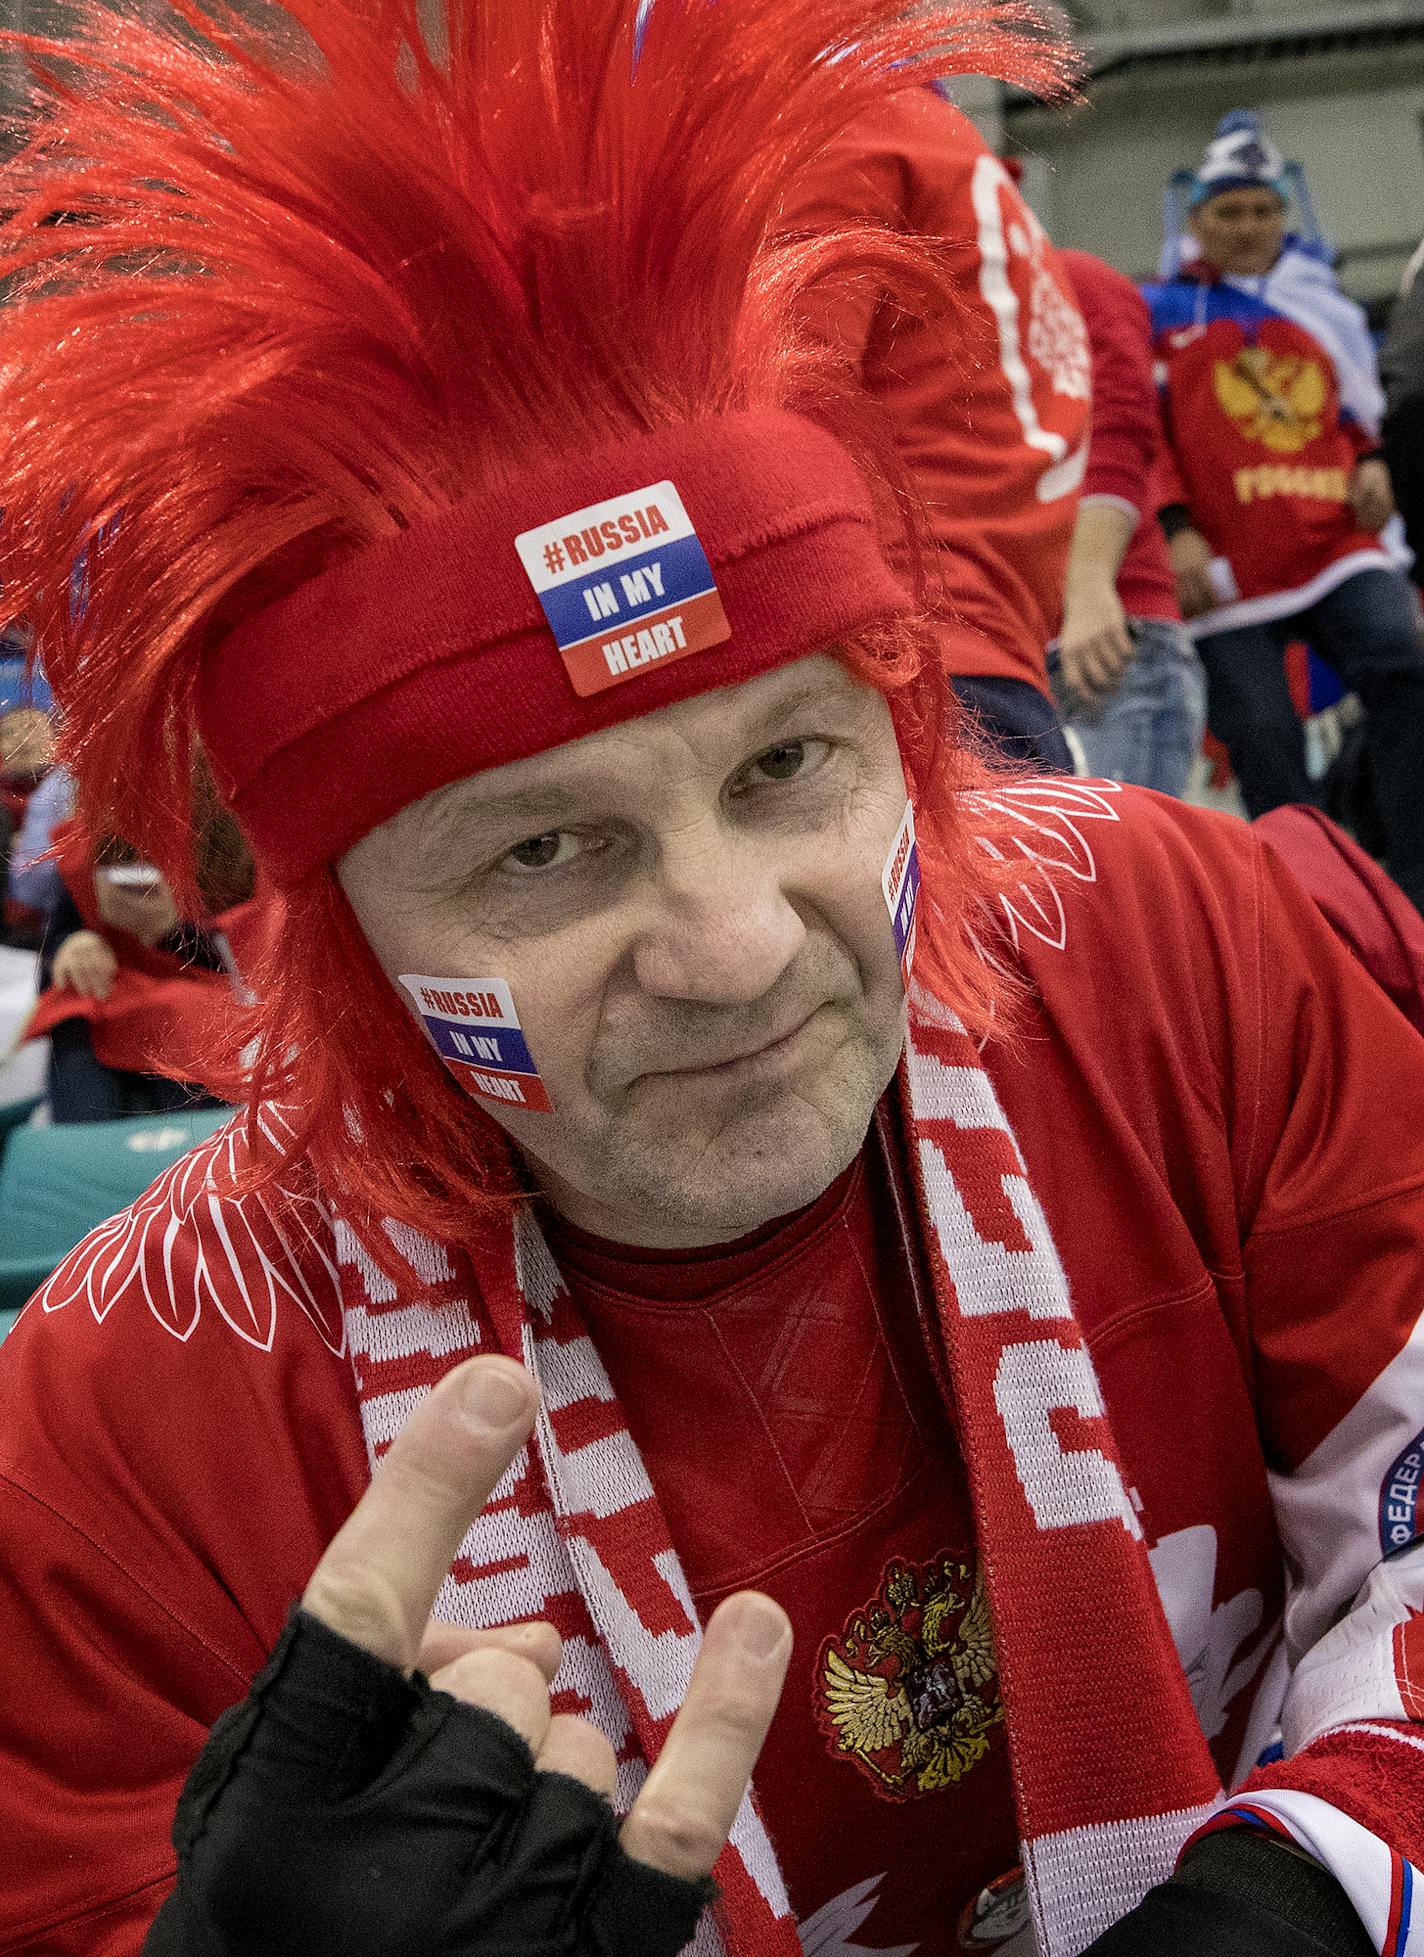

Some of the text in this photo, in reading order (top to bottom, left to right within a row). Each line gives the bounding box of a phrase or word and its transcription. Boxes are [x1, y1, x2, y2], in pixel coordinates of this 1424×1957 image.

[543, 504, 669, 575] #RUSSIA
[582, 562, 666, 622] IN MY
[601, 615, 687, 677] HEART
[420, 987, 504, 1018] #RUSSIA
[449, 1030, 502, 1062] IN MY
[470, 1070, 527, 1102] HEART
